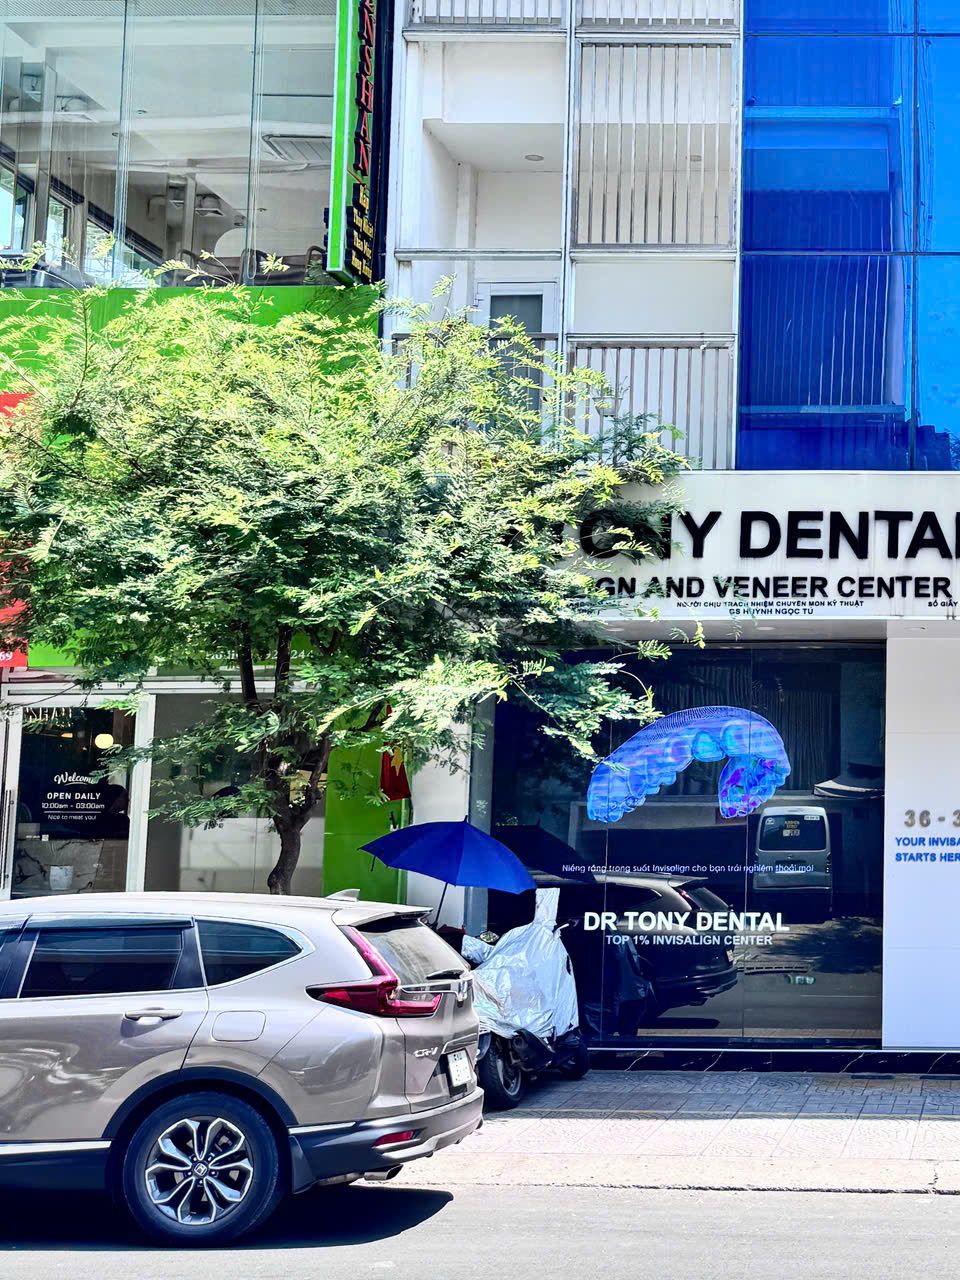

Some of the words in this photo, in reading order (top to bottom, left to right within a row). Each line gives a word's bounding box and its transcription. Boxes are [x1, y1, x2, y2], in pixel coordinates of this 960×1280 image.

[645, 576, 705, 598] AND
[713, 576, 829, 598] VENEER
[837, 576, 953, 598] CENTER
[47, 792, 72, 800] OPEN
[74, 792, 101, 800] DAILY
[904, 809, 931, 828] 36
[895, 837, 926, 847] YOUR
[895, 853, 937, 862] STARTS
[652, 864, 690, 874] Invisalign
[692, 864, 708, 872] cho
[584, 912, 617, 931] DR
[623, 911, 691, 931] TONY
[696, 912, 790, 932] DENTAL
[606, 935, 630, 946] TOP
[633, 935, 650, 946] 1%
[652, 935, 721, 946] INVISALIGN
[724, 935, 773, 946] CENTER
